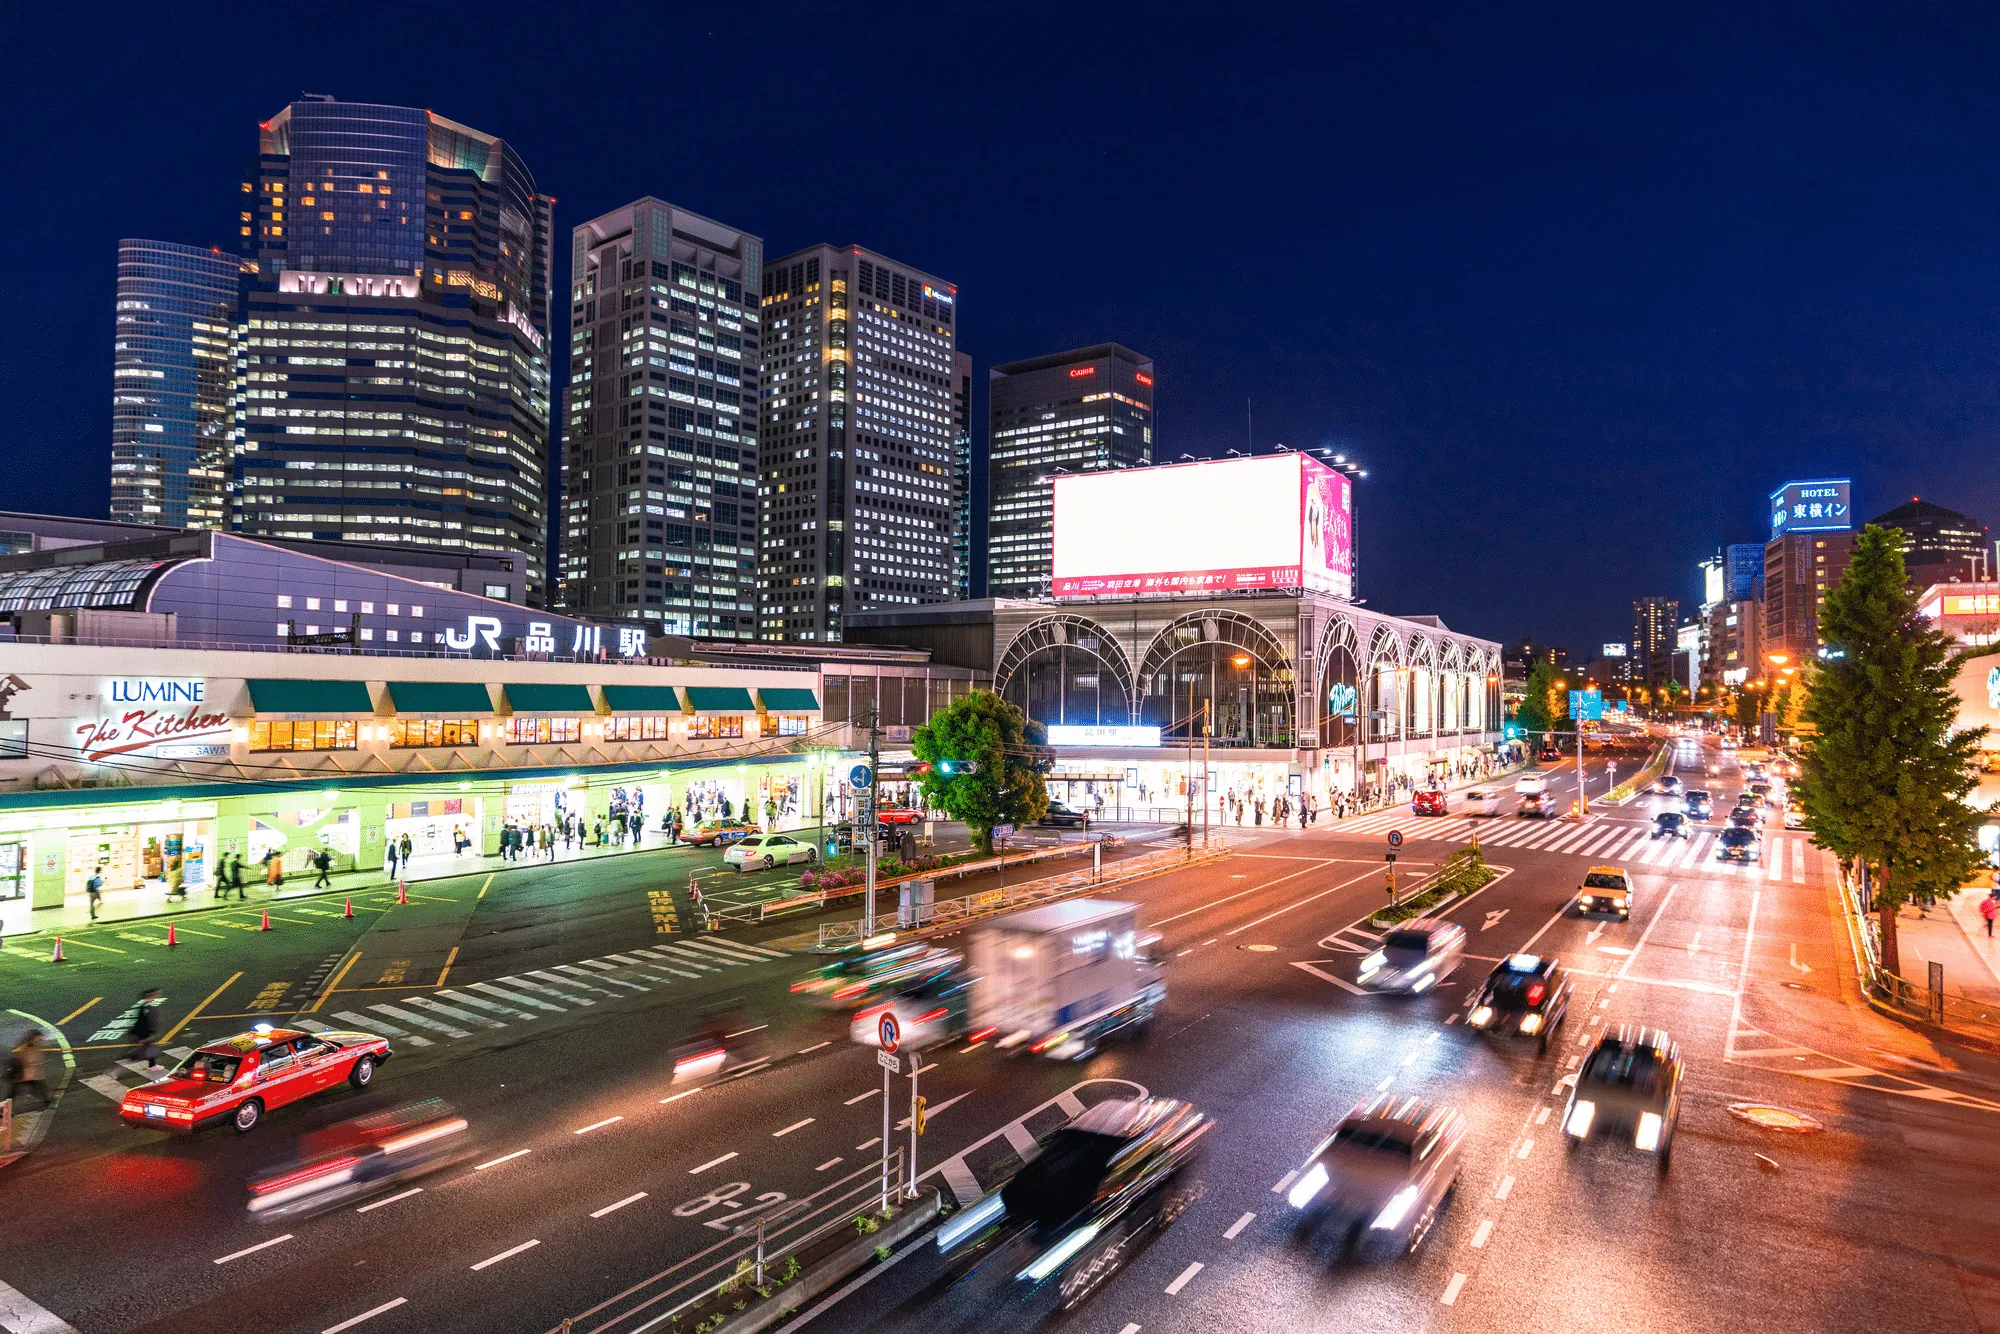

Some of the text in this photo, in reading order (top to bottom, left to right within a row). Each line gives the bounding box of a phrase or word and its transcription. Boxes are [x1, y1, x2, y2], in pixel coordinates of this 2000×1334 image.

[1070, 367, 1094, 377] Canon
[1801, 488, 1839, 498] HOTEL
[1793, 502, 1848, 518] 東横イン
[445, 615, 502, 650] JR
[525, 621, 647, 657] 品川駅
[112, 680, 205, 702] LUMINE
[76, 705, 230, 754] The Kitchen
[162, 746, 226, 756] SGAWA
